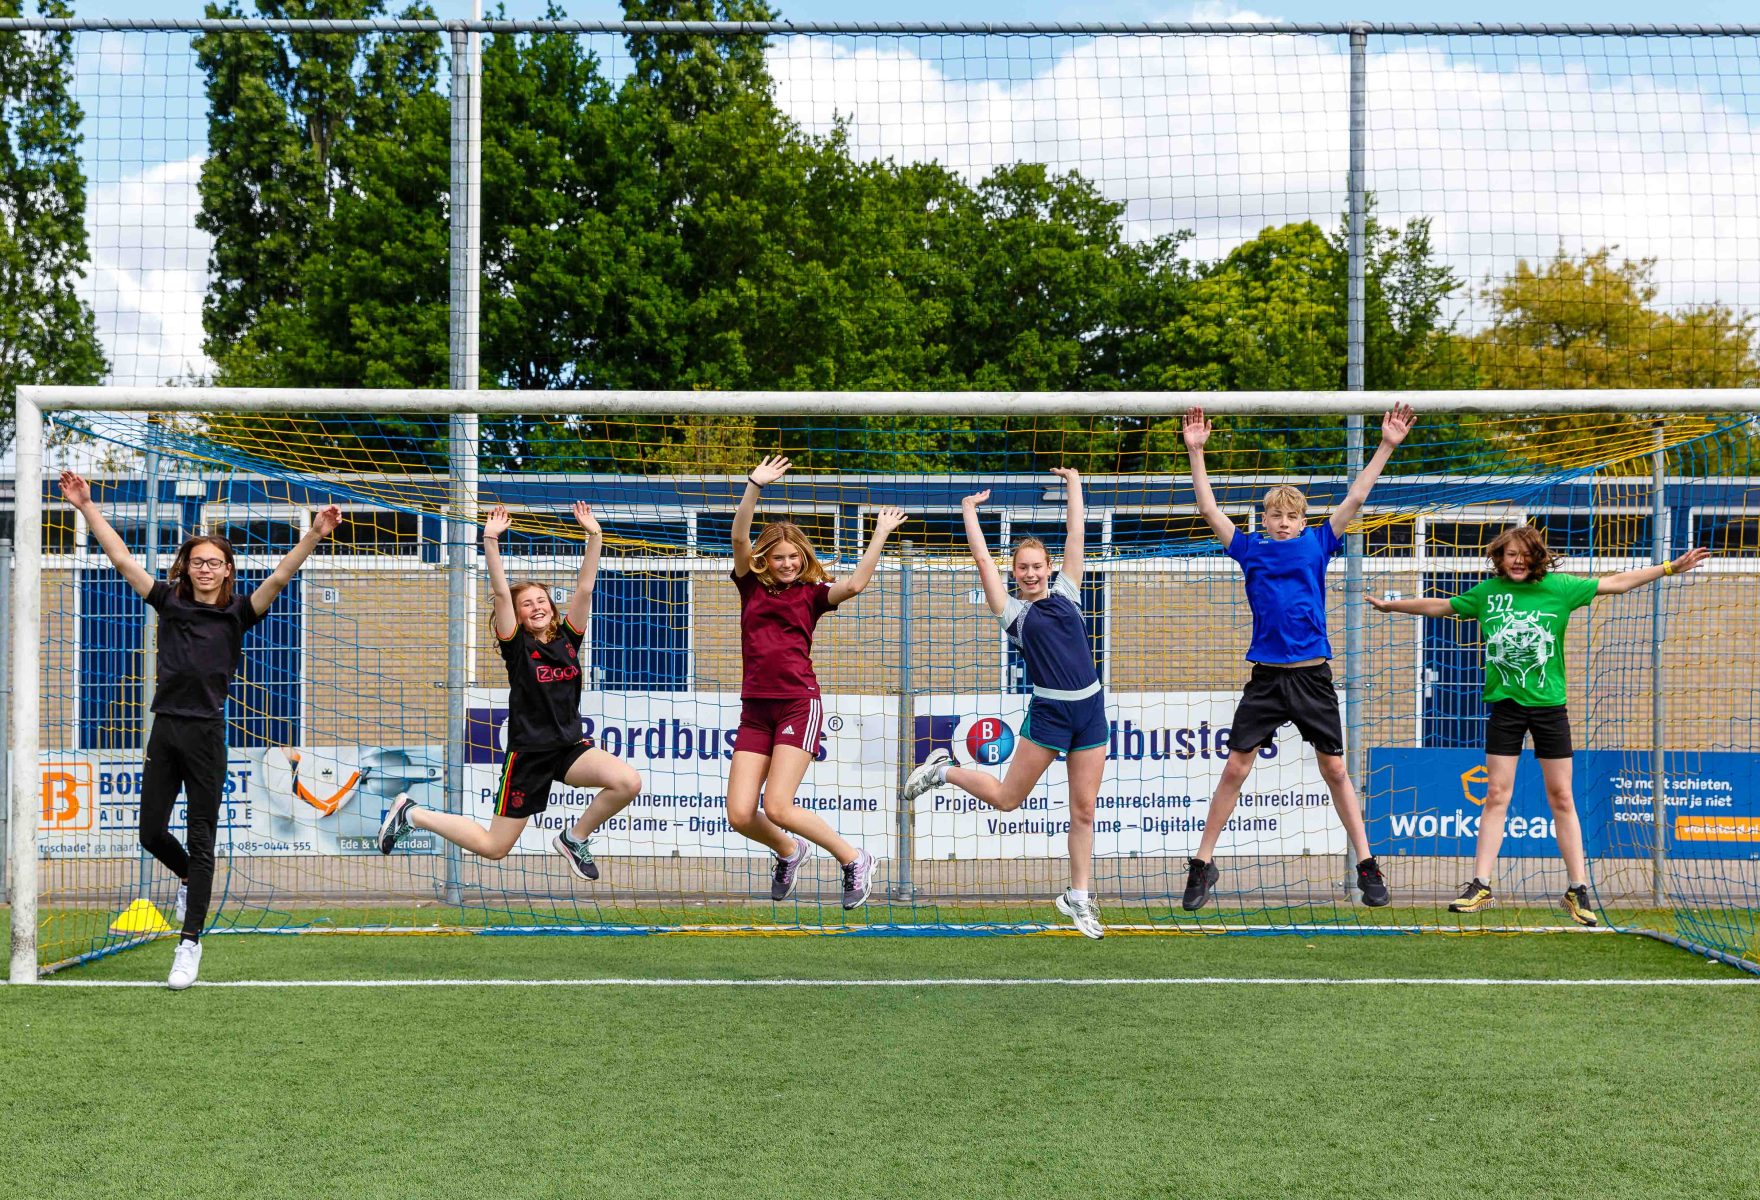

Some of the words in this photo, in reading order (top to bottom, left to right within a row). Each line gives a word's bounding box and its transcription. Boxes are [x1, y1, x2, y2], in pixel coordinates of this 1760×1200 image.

[1487, 593, 1514, 613] 522
[581, 717, 827, 761] ordbus
[982, 721, 993, 740] B
[988, 744, 999, 763] B
[1635, 778, 1670, 789] mot
[1672, 778, 1733, 791] schieten,
[632, 792, 727, 808] nnenreclam
[760, 794, 877, 811] enreclame
[935, 795, 1047, 814] Projecden
[1096, 793, 1191, 808] nenreclame
[1234, 791, 1329, 807] tenreclame
[1614, 794, 1654, 805] ander
[1663, 795, 1688, 806] kun
[1689, 795, 1702, 809] je
[1705, 795, 1733, 807] niet
[533, 814, 667, 833] Voertreclame
[689, 816, 735, 835] Digita
[987, 818, 1121, 836] Voertuigreme
[1143, 816, 1206, 835] Digitale
[1221, 816, 1277, 832] clame
[1390, 809, 1557, 839] worksea
[1614, 811, 1655, 822] score
[38, 842, 91, 853] toschade?
[94, 843, 106, 854] ga
[110, 843, 132, 852] naar
[237, 842, 289, 852] 085-0444
[293, 841, 311, 851] 555
[340, 839, 358, 849] Ede
[361, 839, 370, 849] &
[373, 838, 431, 849] Vendaal
